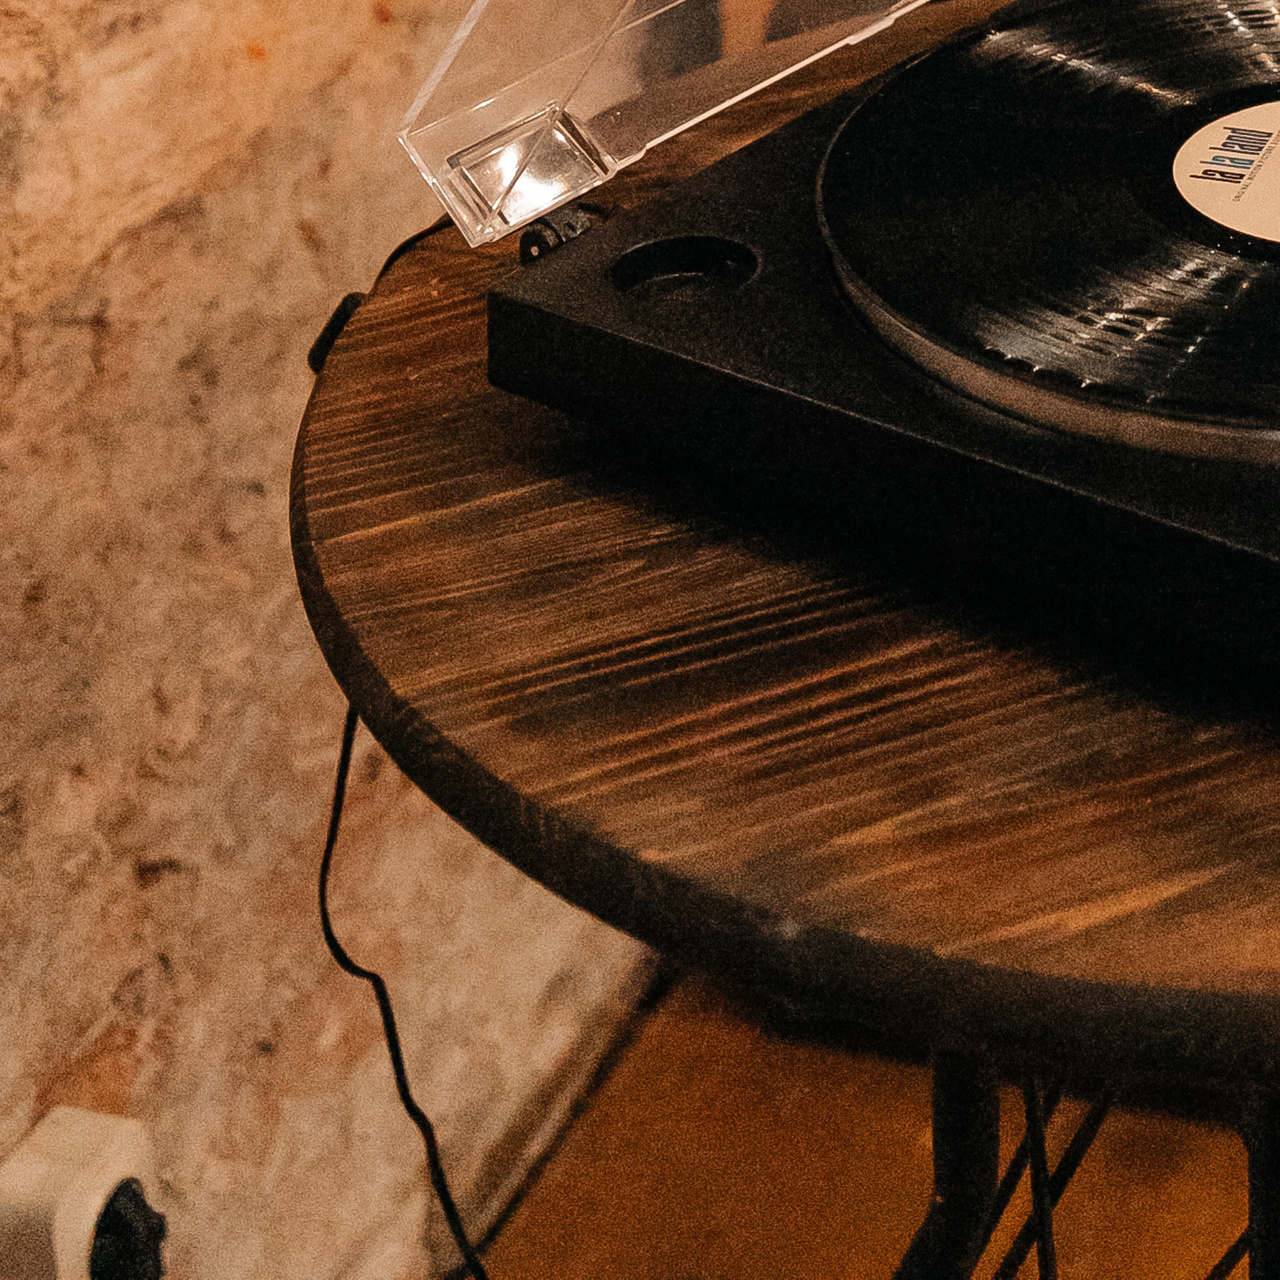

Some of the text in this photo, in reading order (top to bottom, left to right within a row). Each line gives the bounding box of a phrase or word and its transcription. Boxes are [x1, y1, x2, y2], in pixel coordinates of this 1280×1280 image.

[1189, 126, 1274, 184] la la land
